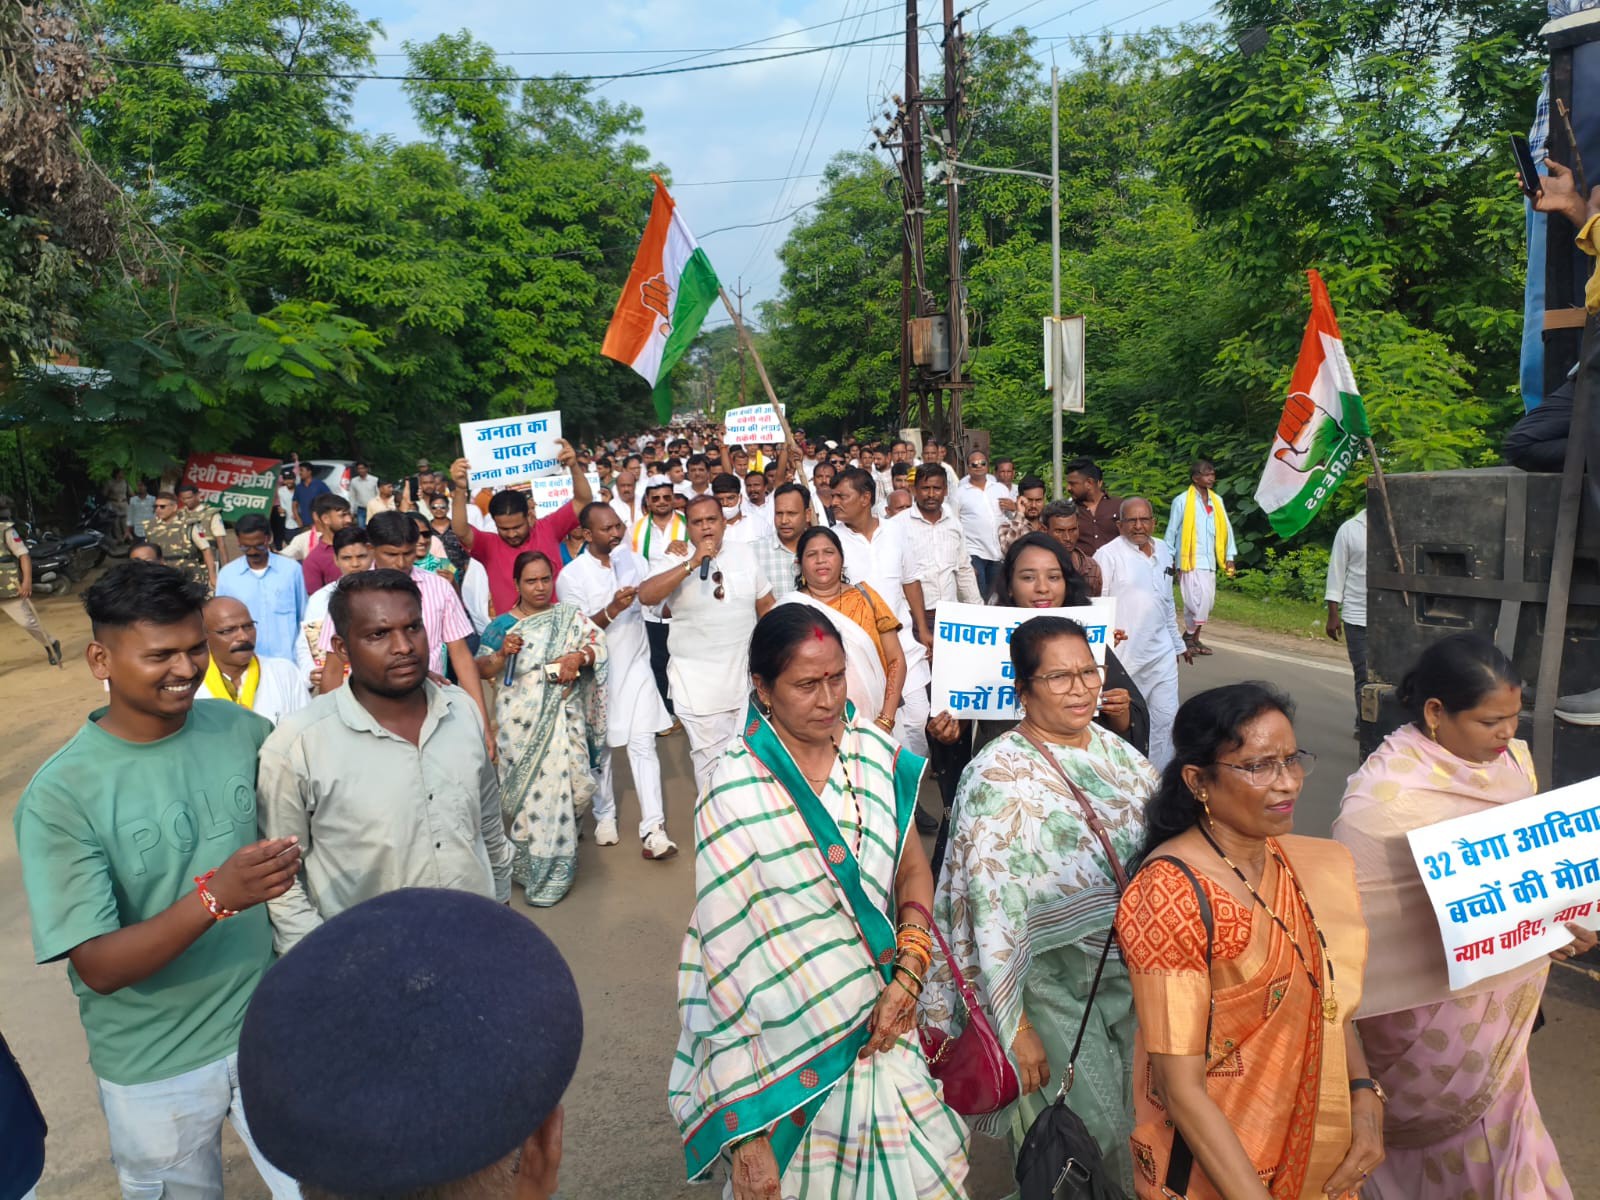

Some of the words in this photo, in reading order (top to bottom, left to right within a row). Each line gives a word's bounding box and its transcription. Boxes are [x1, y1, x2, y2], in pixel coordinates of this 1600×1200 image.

[475, 422, 523, 441] जनता
[526, 419, 548, 434] का
[492, 442, 537, 460] चावल
[188, 464, 217, 483] देशी
[217, 470, 231, 484] व
[471, 469, 502, 481] जनता
[505, 465, 519, 475] का
[222, 492, 269, 512] दुकान
[939, 621, 999, 645] चावल
[949, 686, 993, 710] करों
[117, 775, 257, 876] POLO
[1423, 852, 1457, 880] 32
[1452, 834, 1510, 866] बैगा
[1513, 805, 1600, 853] आदिवा
[1445, 880, 1507, 923] बच्चों
[1509, 870, 1548, 903] की
[1551, 858, 1600, 890] मौत
[1454, 937, 1494, 962] न्याय
[1553, 902, 1593, 923] न्याय
